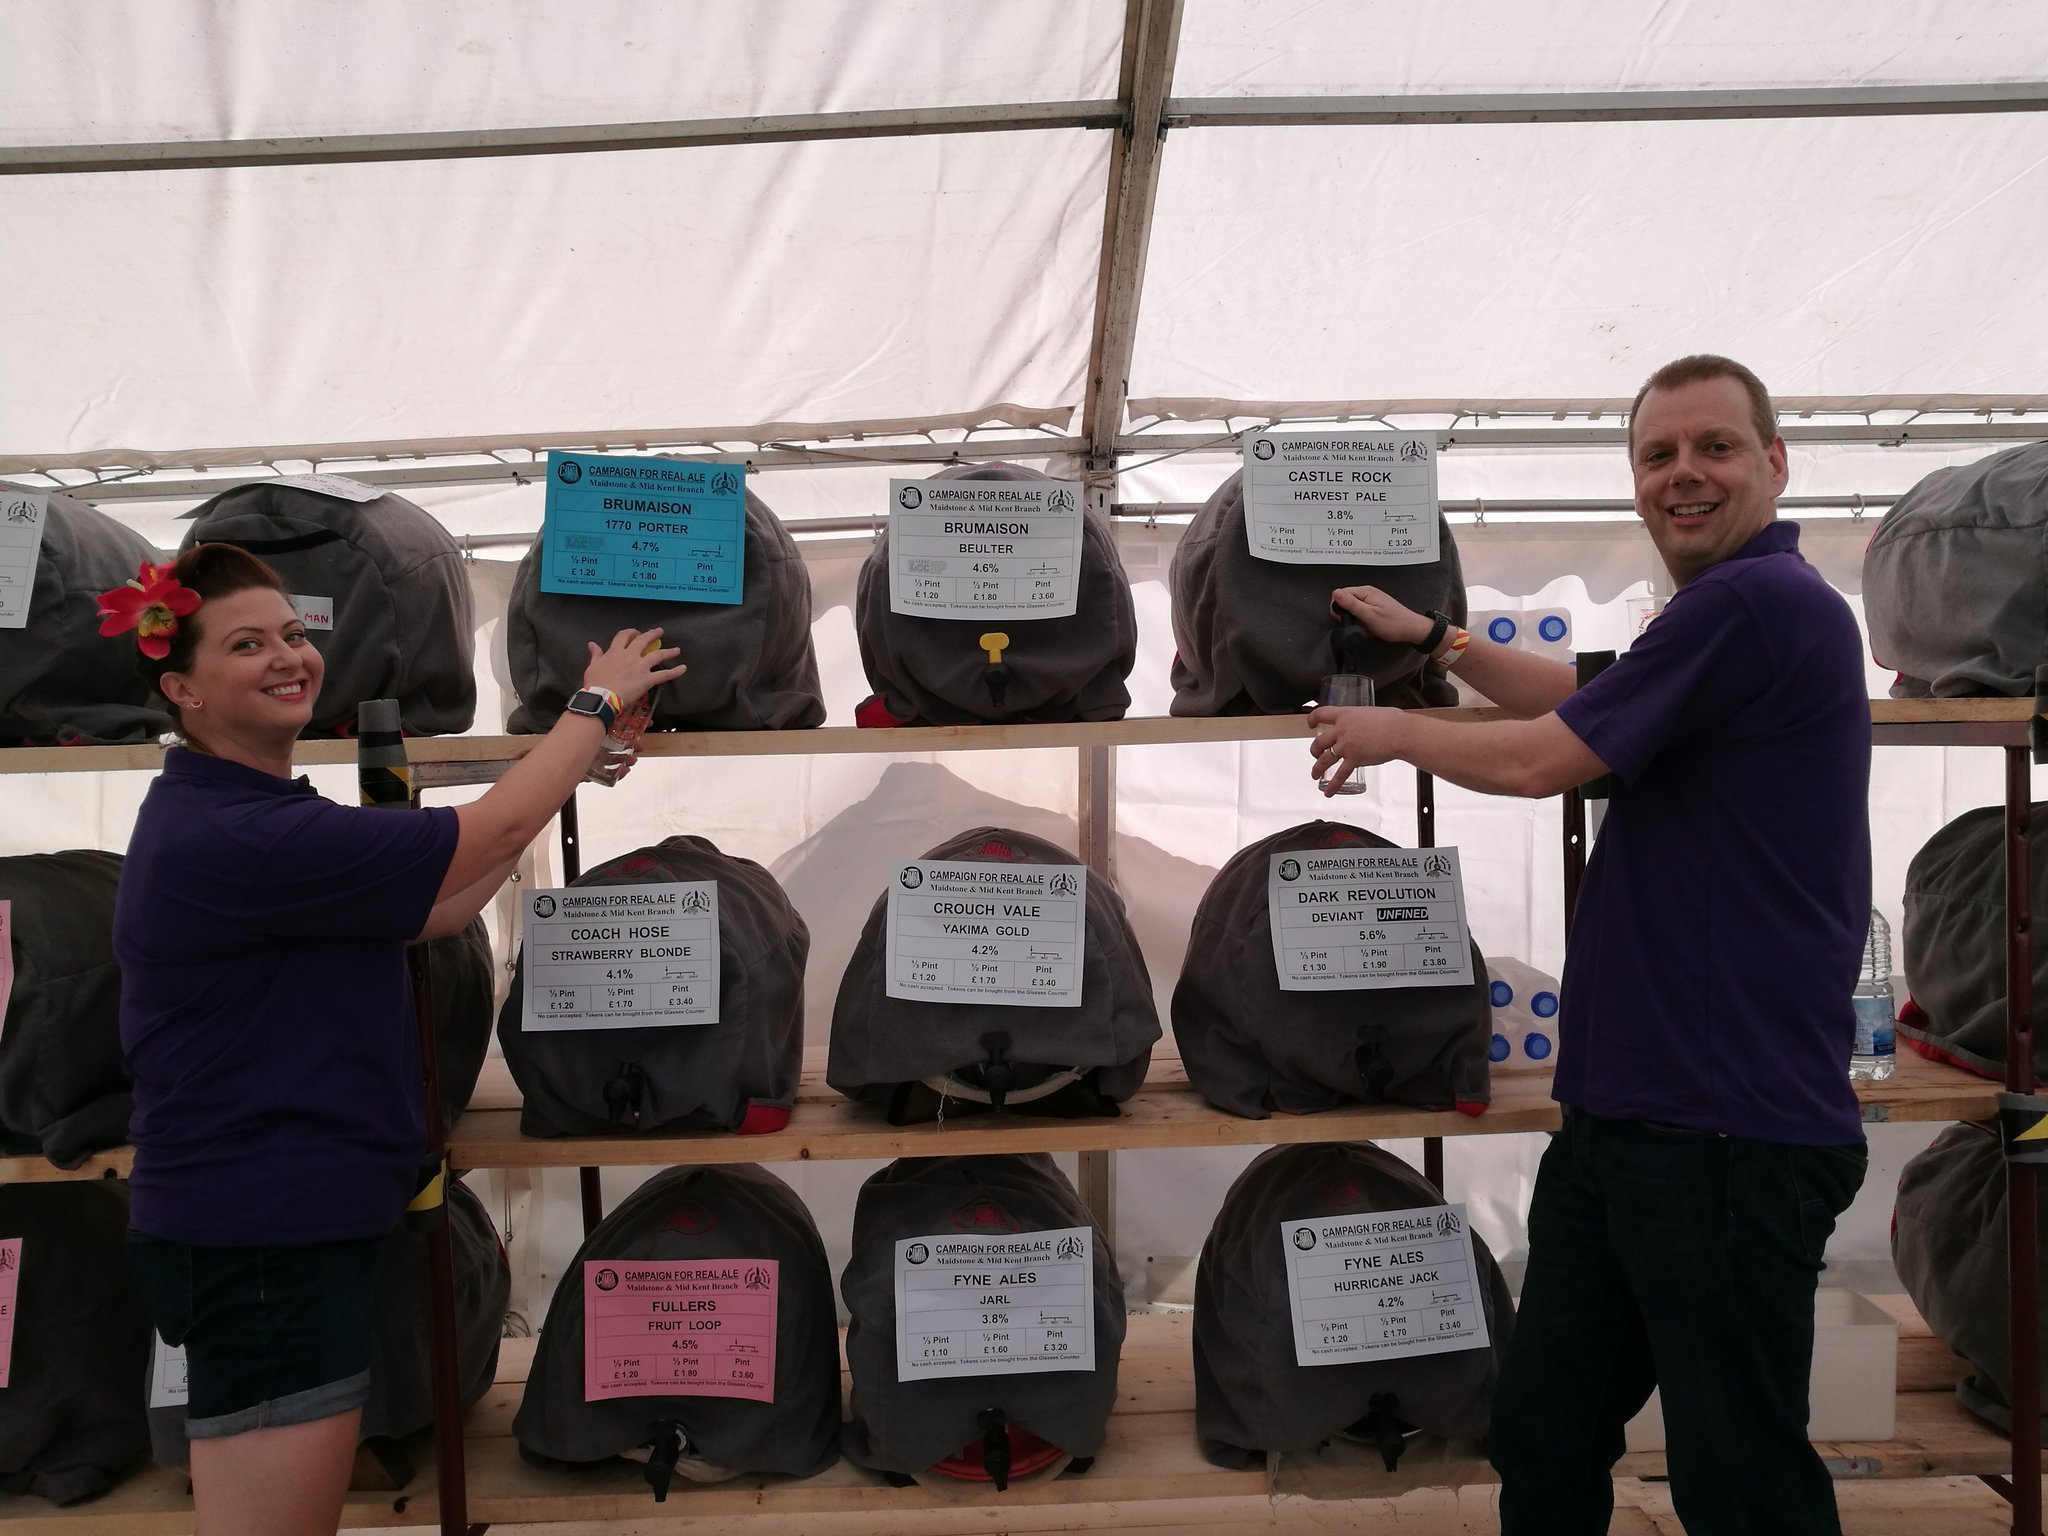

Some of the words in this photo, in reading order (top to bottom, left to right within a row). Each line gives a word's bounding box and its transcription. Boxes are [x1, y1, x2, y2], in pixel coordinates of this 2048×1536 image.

[1282, 442, 1328, 450] CAMPAIGN
[1332, 442, 1349, 450] FOR
[1352, 442, 1375, 450] REAL
[589, 466, 636, 477] CAMPAIGN
[640, 469, 658, 478] FOR
[661, 471, 685, 480] REAL
[688, 473, 705, 481] ALE
[1289, 471, 1343, 482] CASTLE
[1352, 472, 1391, 482] ROCK
[589, 480, 627, 488] Maidstone
[657, 484, 675, 492] Kent
[678, 485, 704, 493] Branch
[929, 490, 975, 499] CAMPAIGN
[978, 491, 996, 500] FOR
[999, 492, 1022, 500] REAL
[1025, 492, 1041, 500] ALE
[1295, 492, 1349, 500] HARVEST
[1356, 492, 1386, 501] PALE
[604, 499, 691, 514] BRUMAISON
[1328, 511, 1353, 519] 3.8%
[605, 521, 631, 530] 1770
[639, 522, 688, 534] PORTER
[945, 523, 1028, 534] BRUMAISON
[632, 542, 659, 552] 4.7%
[960, 544, 1013, 553] BEULTER
[698, 563, 713, 571] Pint
[973, 564, 999, 573] 4.6%
[1307, 859, 1354, 869] CAMPAIGN
[1358, 859, 1375, 867] FOR
[1378, 858, 1400, 866] REAL
[1403, 858, 1418, 866] ALE
[930, 871, 976, 881] CAMPAIGN
[980, 873, 997, 881] FOR
[1001, 874, 1024, 883] REAL
[1026, 874, 1044, 883] ALE
[1309, 873, 1348, 881] Maidstone
[931, 884, 968, 892] Maidstone
[563, 897, 607, 906] CAMPAIGN
[610, 896, 628, 905] FOR
[631, 895, 654, 904] REAL
[657, 894, 675, 903] ALE
[1299, 891, 1339, 903] DARK
[1348, 888, 1436, 901] REVOLUTION
[934, 903, 995, 915] CROUCH
[1004, 906, 1040, 917] VALE
[1312, 911, 1363, 922] DEVIANT
[1378, 909, 1428, 920] UNFINED
[571, 928, 620, 940] COACH
[630, 926, 669, 938] HOSE
[943, 924, 989, 935] YAKIMA
[996, 927, 1029, 936] GOLD
[1359, 931, 1386, 939] 5.6%
[552, 950, 633, 960] STRAWBERRY
[641, 947, 691, 958] BLONDE
[972, 946, 998, 955] 4.2%
[607, 969, 633, 979] 4.1%
[1322, 1224, 1370, 1237] CAMPAIGN
[1372, 1223, 1390, 1232] FOR
[1393, 1220, 1415, 1230] REAL
[1417, 1217, 1432, 1227] ALE
[1325, 1240, 1363, 1249] Maidstone
[1375, 1236, 1389, 1244] Mid
[1391, 1234, 1407, 1243] Kent
[1409, 1232, 1433, 1241] Branch
[936, 1245, 983, 1254] CAMPAIGN
[987, 1245, 1005, 1253] FOR
[1008, 1244, 1031, 1252] REAL
[1033, 1241, 1051, 1250] ALE
[1345, 1256, 1382, 1270] FYNE
[1390, 1251, 1424, 1265] ALES
[625, 1272, 671, 1280] CAMPAIGN
[675, 1271, 692, 1279] FOR
[696, 1271, 719, 1279] REAL
[721, 1270, 738, 1278] ALE
[955, 1275, 991, 1285] FYNE
[1000, 1273, 1036, 1285] ALES
[1334, 1276, 1403, 1291] HURRICANE
[1410, 1271, 1438, 1283] JACK
[980, 1295, 1010, 1304] JARL
[1378, 1296, 1404, 1308] 4.2%
[653, 1301, 716, 1312] FULLERS
[982, 1314, 1008, 1323] 3.8%
[649, 1322, 682, 1330] FRUIT
[690, 1321, 721, 1330] LOOP
[672, 1340, 698, 1349] 4.5%
[735, 1358, 750, 1366] Pint
